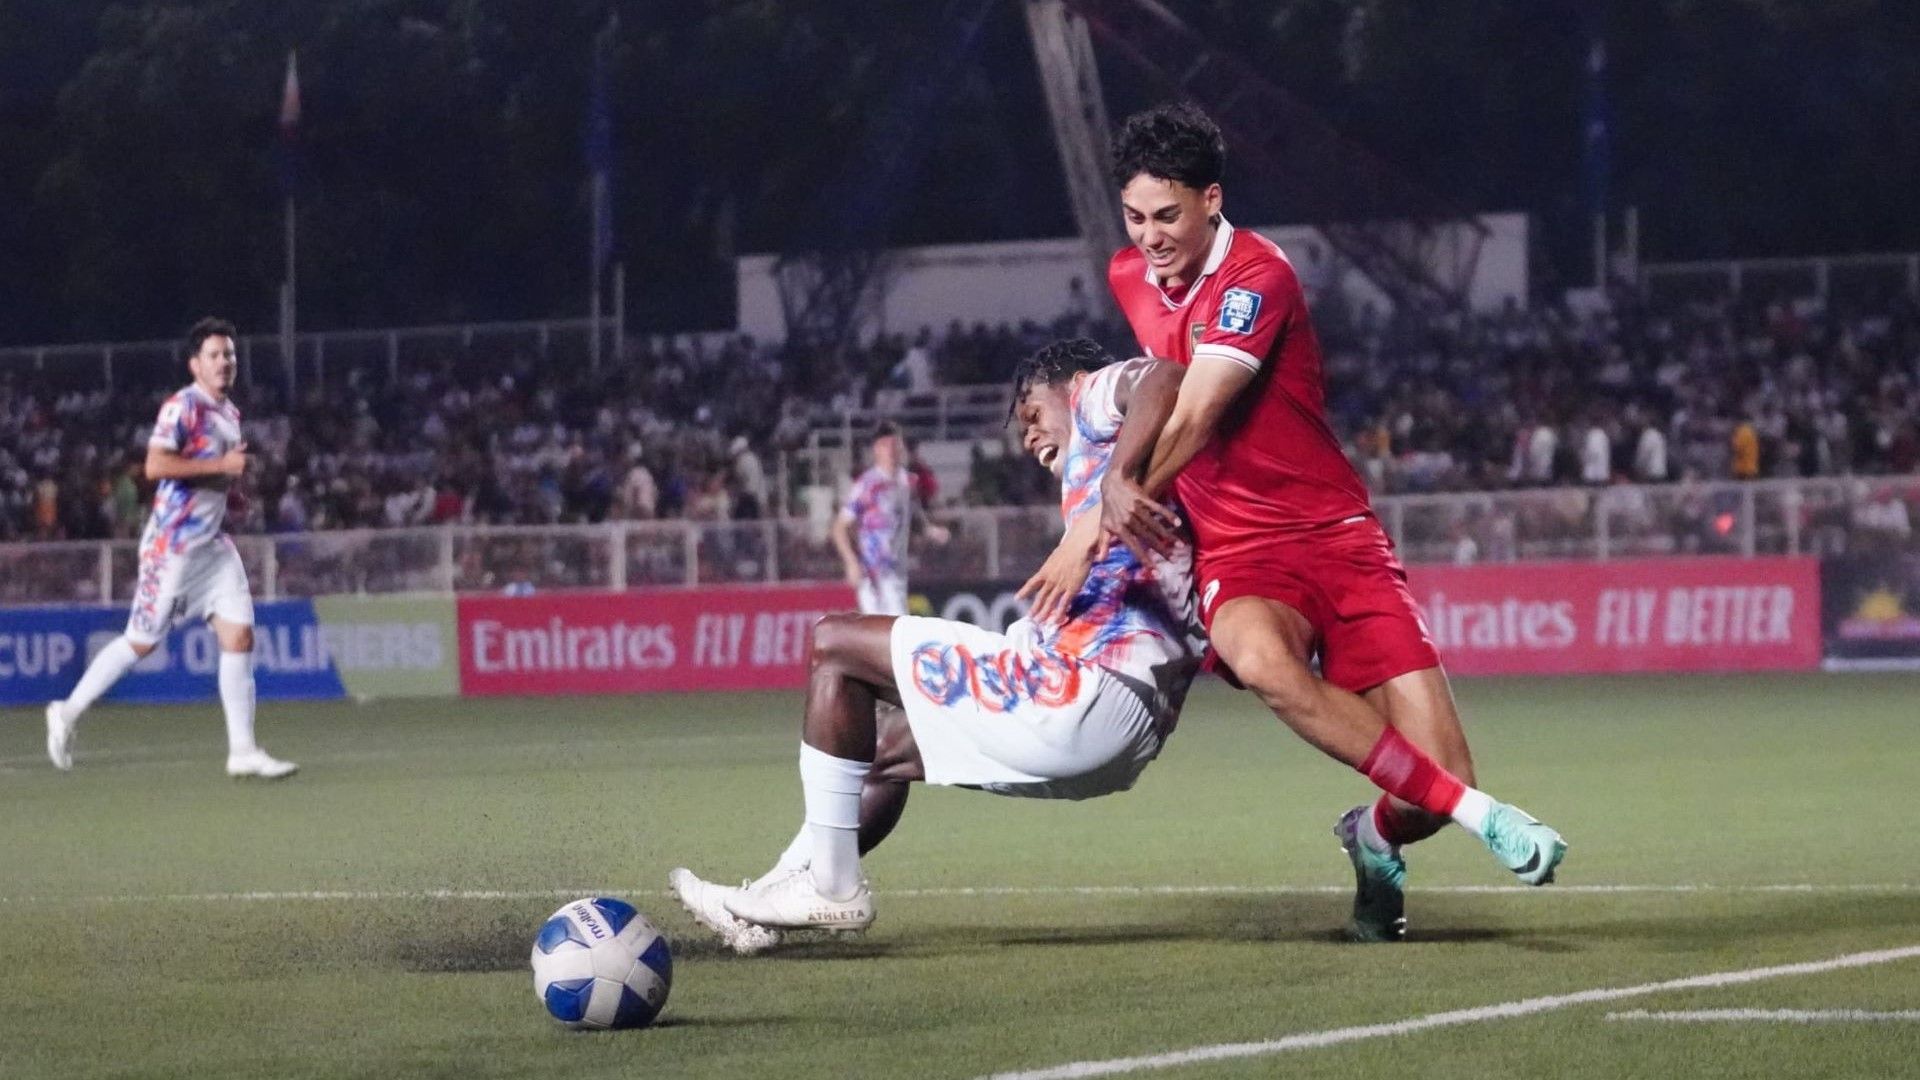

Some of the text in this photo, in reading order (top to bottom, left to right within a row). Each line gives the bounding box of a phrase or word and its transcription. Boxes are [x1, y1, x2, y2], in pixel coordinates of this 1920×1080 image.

[473, 610, 825, 672] Emirates FLY BET
[1426, 591, 1577, 648] irates
[1596, 588, 1657, 645] FLY
[1662, 584, 1794, 644] BETTER
[184, 622, 442, 675] QALIFIERS
[572, 904, 605, 939] molten
[808, 909, 865, 921] ATHLETA
